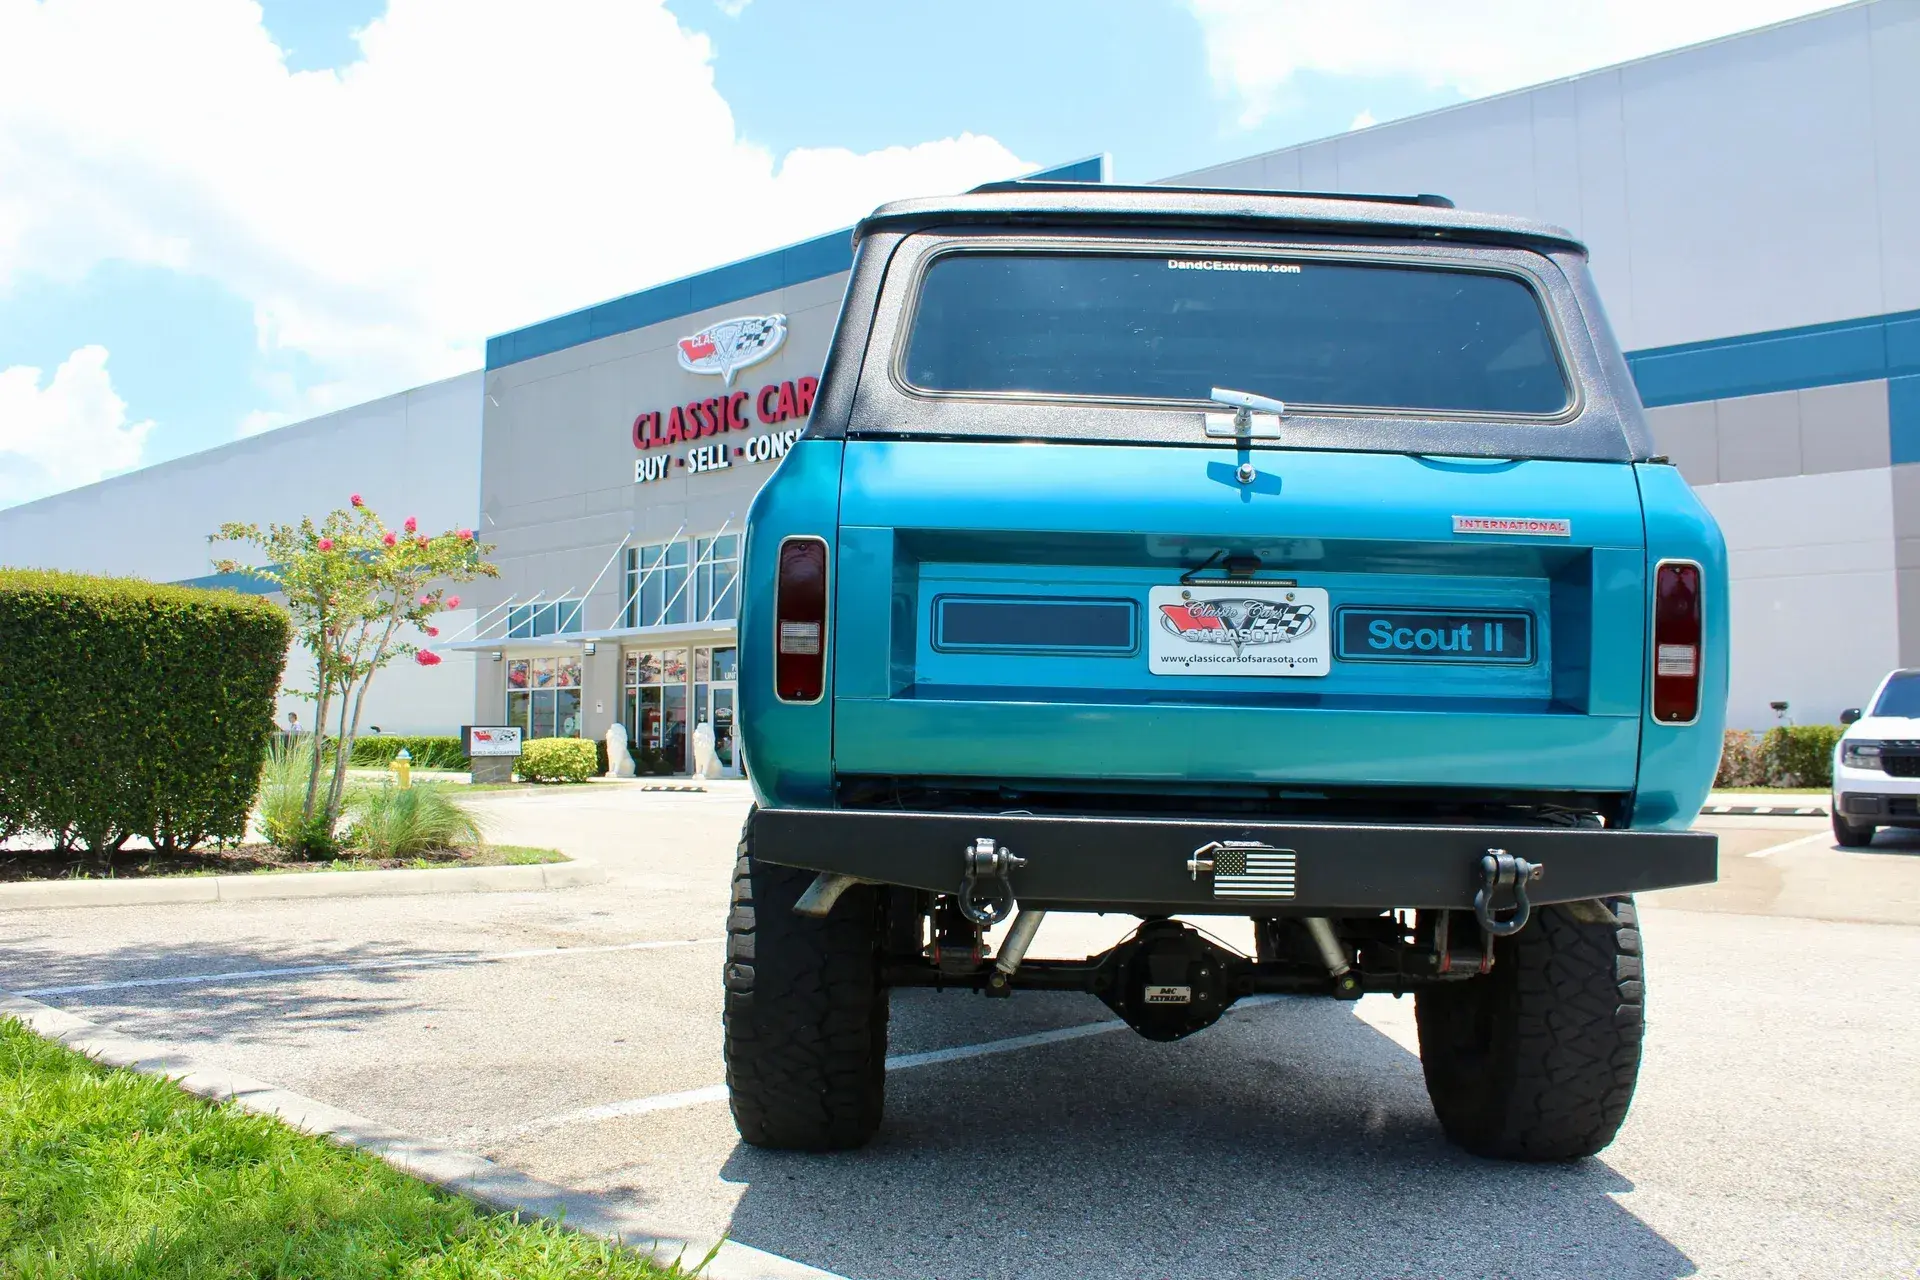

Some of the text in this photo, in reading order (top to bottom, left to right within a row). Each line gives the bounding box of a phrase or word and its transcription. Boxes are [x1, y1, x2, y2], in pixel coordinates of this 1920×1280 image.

[1167, 259, 1301, 274] DandCExtreme.com
[691, 320, 763, 348] CLASSIC CARS
[632, 391, 749, 450] CLASSIC
[634, 454, 670, 484] BUY
[687, 443, 731, 474] SELL
[1459, 519, 1566, 532] INTERNATIONAL
[1182, 599, 1288, 619] Classic Cars
[1184, 628, 1292, 644] SARASOTA
[1367, 619, 1504, 652] Scout II
[1160, 654, 1319, 665] www.classiccarsofsarasota.com
